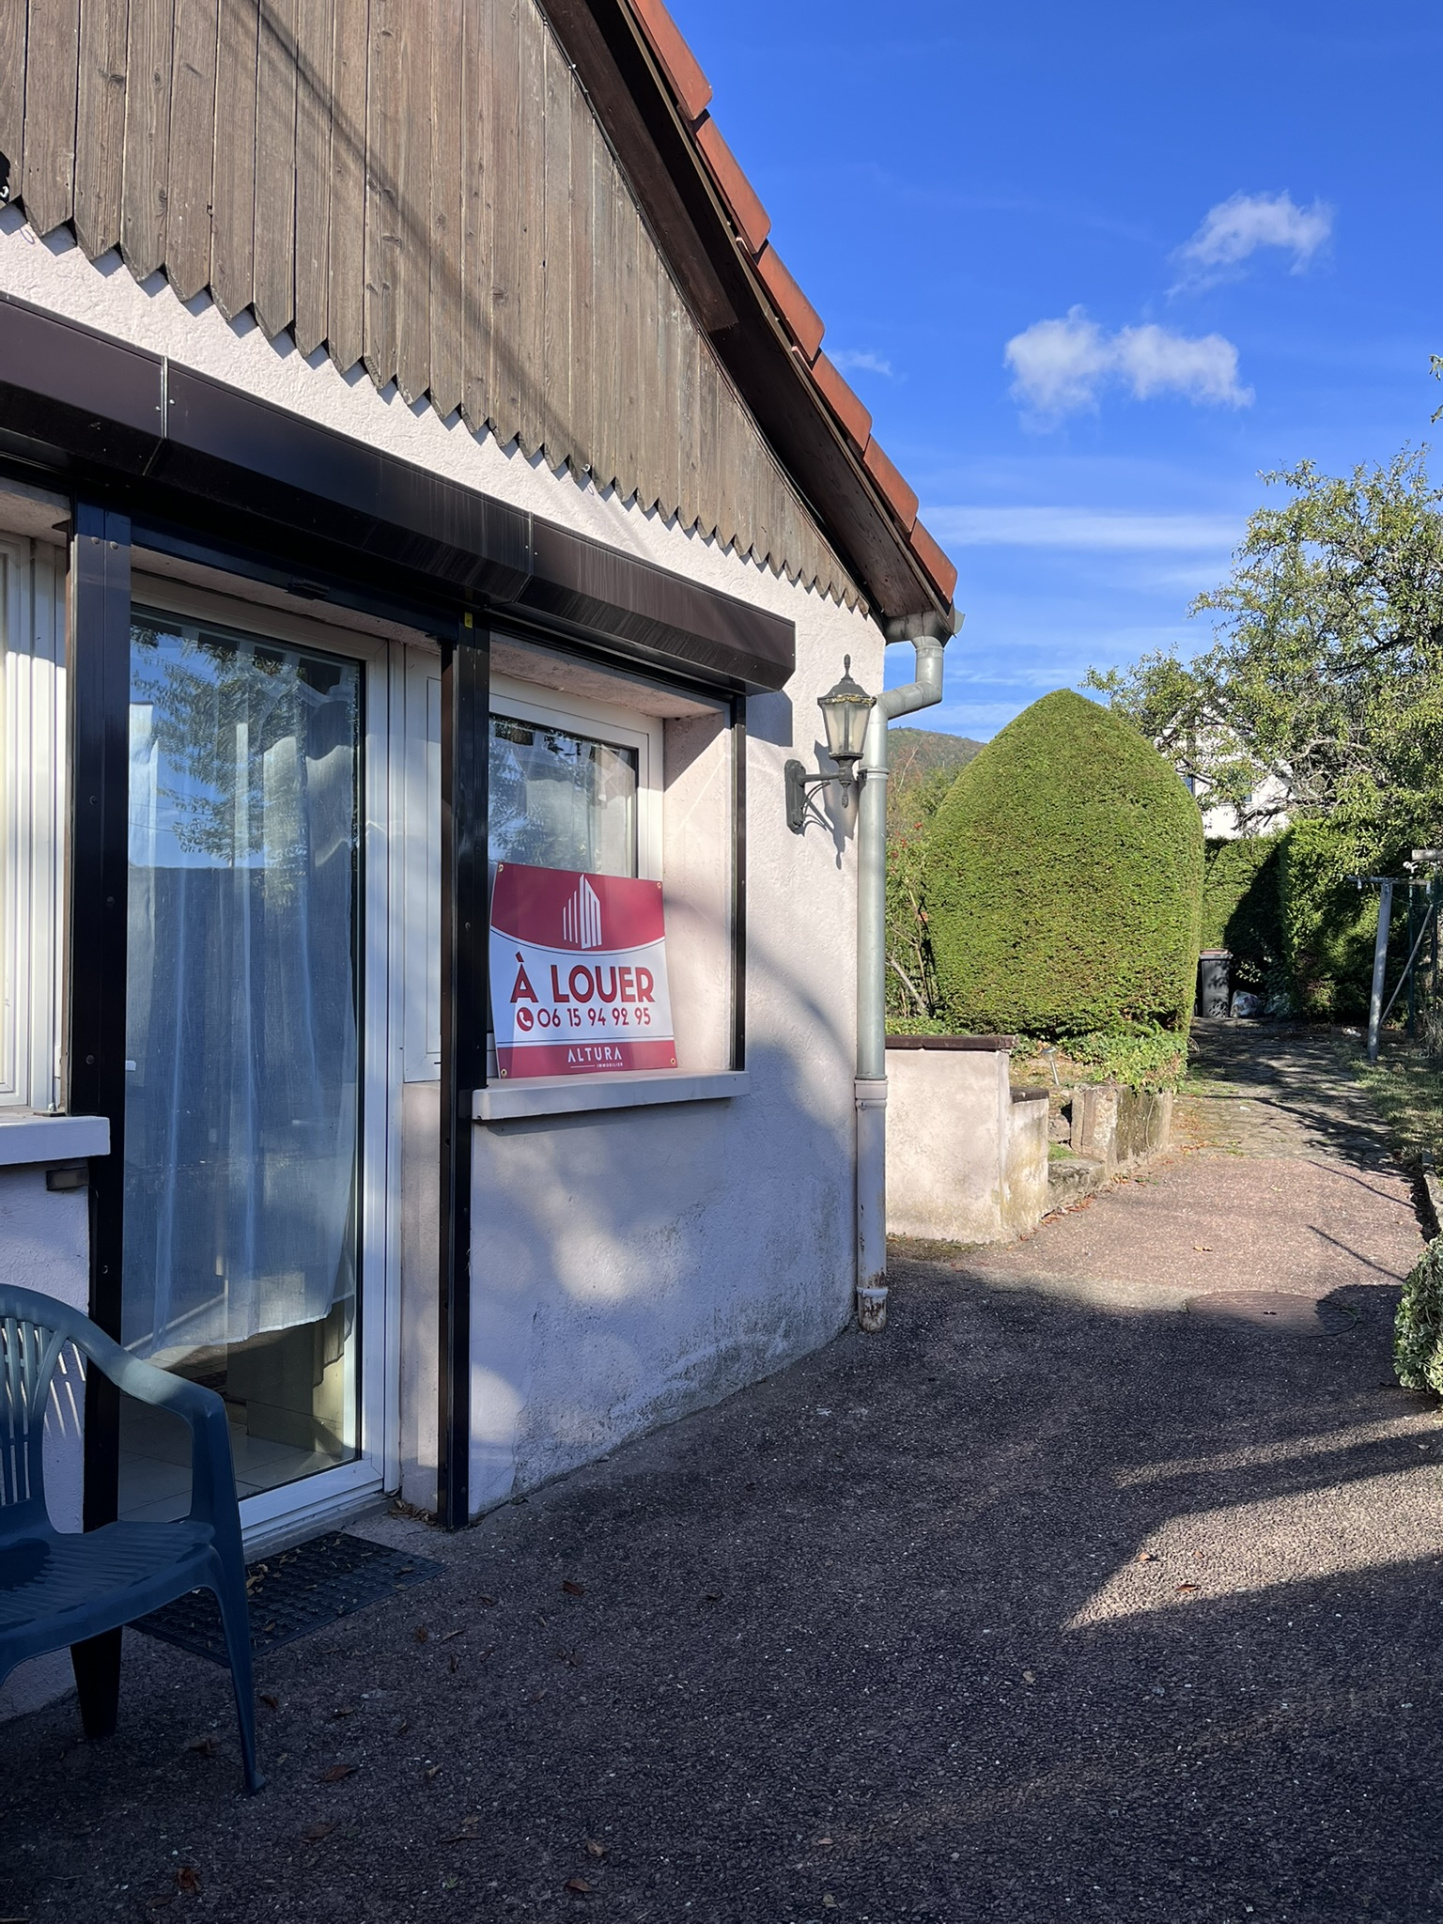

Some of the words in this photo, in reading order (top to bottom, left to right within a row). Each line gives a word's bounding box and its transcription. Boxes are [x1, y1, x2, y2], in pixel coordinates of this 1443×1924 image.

[510, 951, 539, 1003] À
[550, 965, 655, 1003] LOUER
[537, 1008, 561, 1028] 06
[567, 1008, 581, 1027] 15
[588, 1008, 606, 1027] 94
[612, 1008, 630, 1027] 92
[634, 1007, 650, 1026] 95
[568, 1046, 622, 1063] ALTURA
